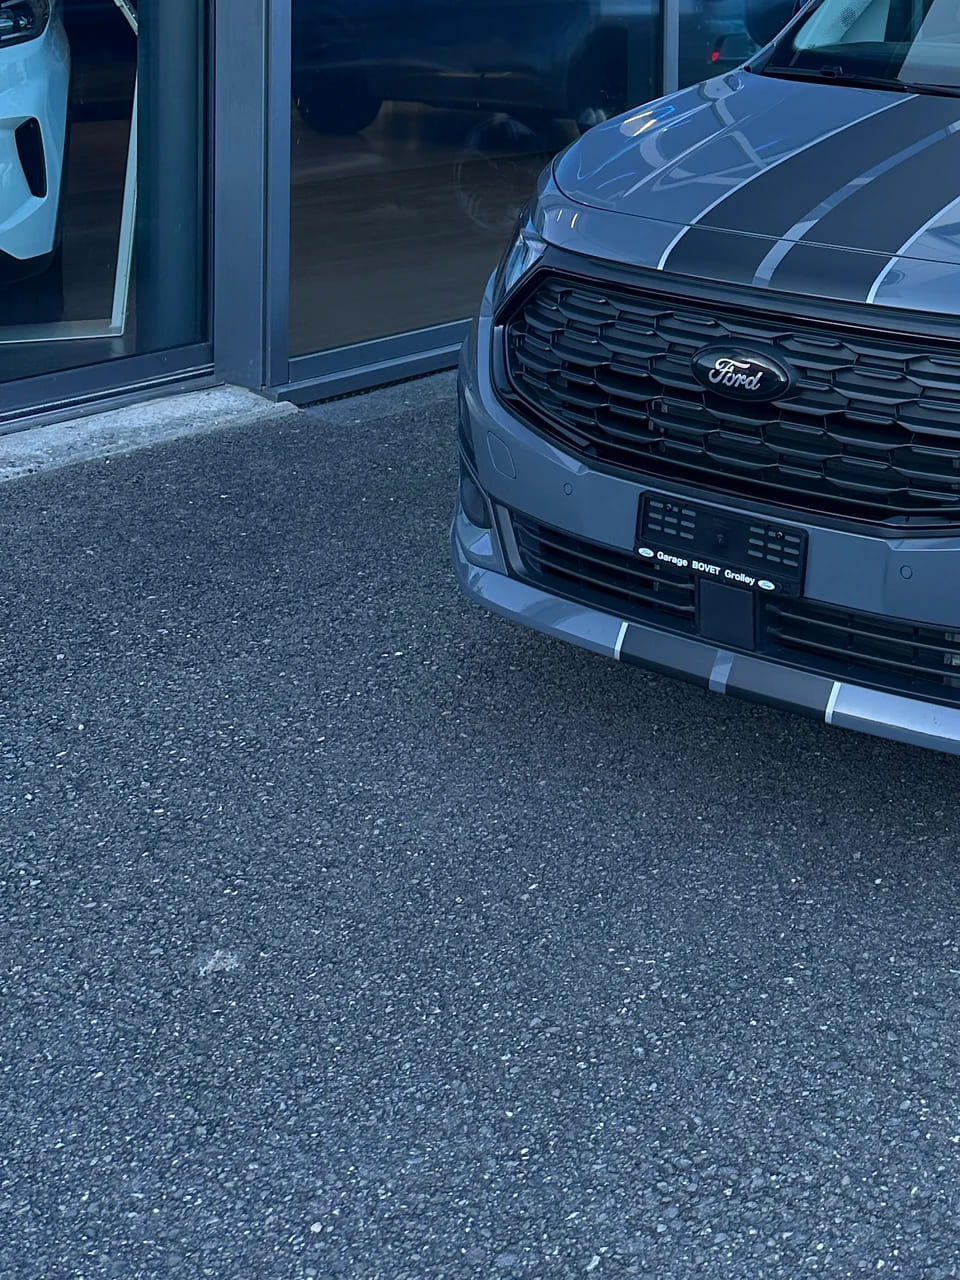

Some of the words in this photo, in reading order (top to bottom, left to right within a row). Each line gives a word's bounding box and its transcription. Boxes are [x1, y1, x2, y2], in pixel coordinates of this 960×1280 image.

[708, 358, 763, 391] Ford
[656, 551, 689, 567] Garage
[691, 560, 721, 576] BOVET
[724, 569, 756, 587] Grolley
